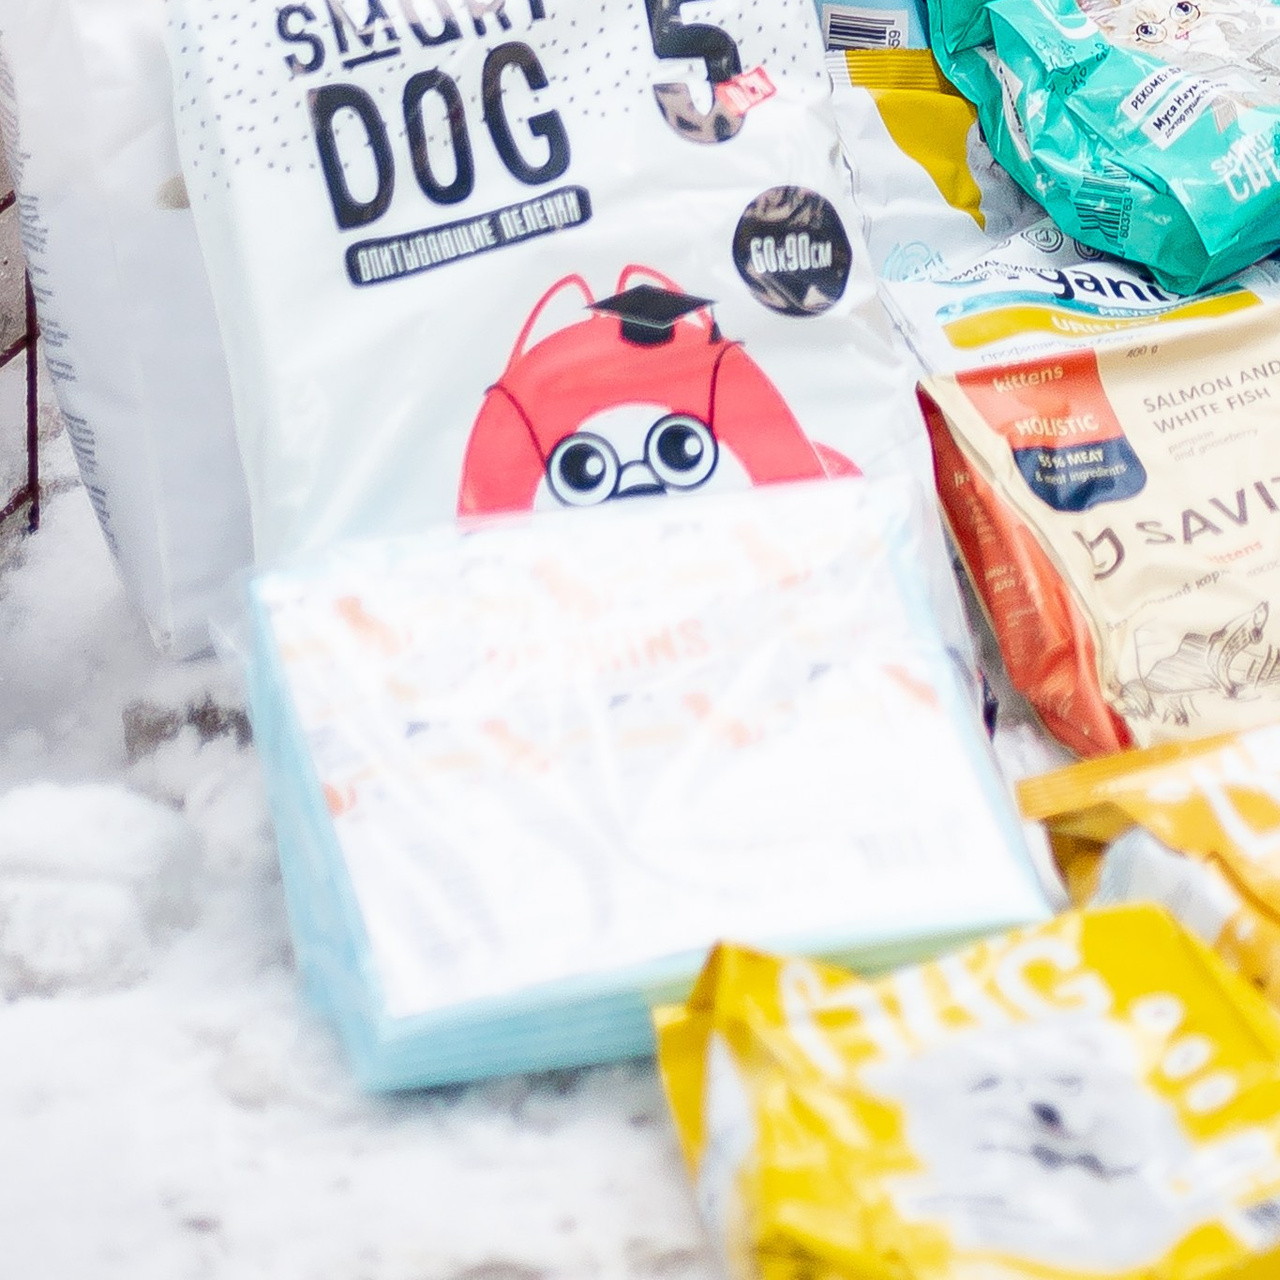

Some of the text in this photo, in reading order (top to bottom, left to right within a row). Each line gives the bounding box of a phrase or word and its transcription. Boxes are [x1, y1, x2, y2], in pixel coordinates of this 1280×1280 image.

[306, 40, 572, 234] DOG
[357, 191, 583, 283] ВПИТЫВАЮЩИЕ ПЕЛЕНКИ
[991, 365, 1065, 394] kittens
[1142, 374, 1233, 415] SALMON
[1014, 414, 1101, 438] HOLISTIC
[1152, 386, 1272, 435] WHITE FISH
[1066, 448, 1105, 466] MEAT
